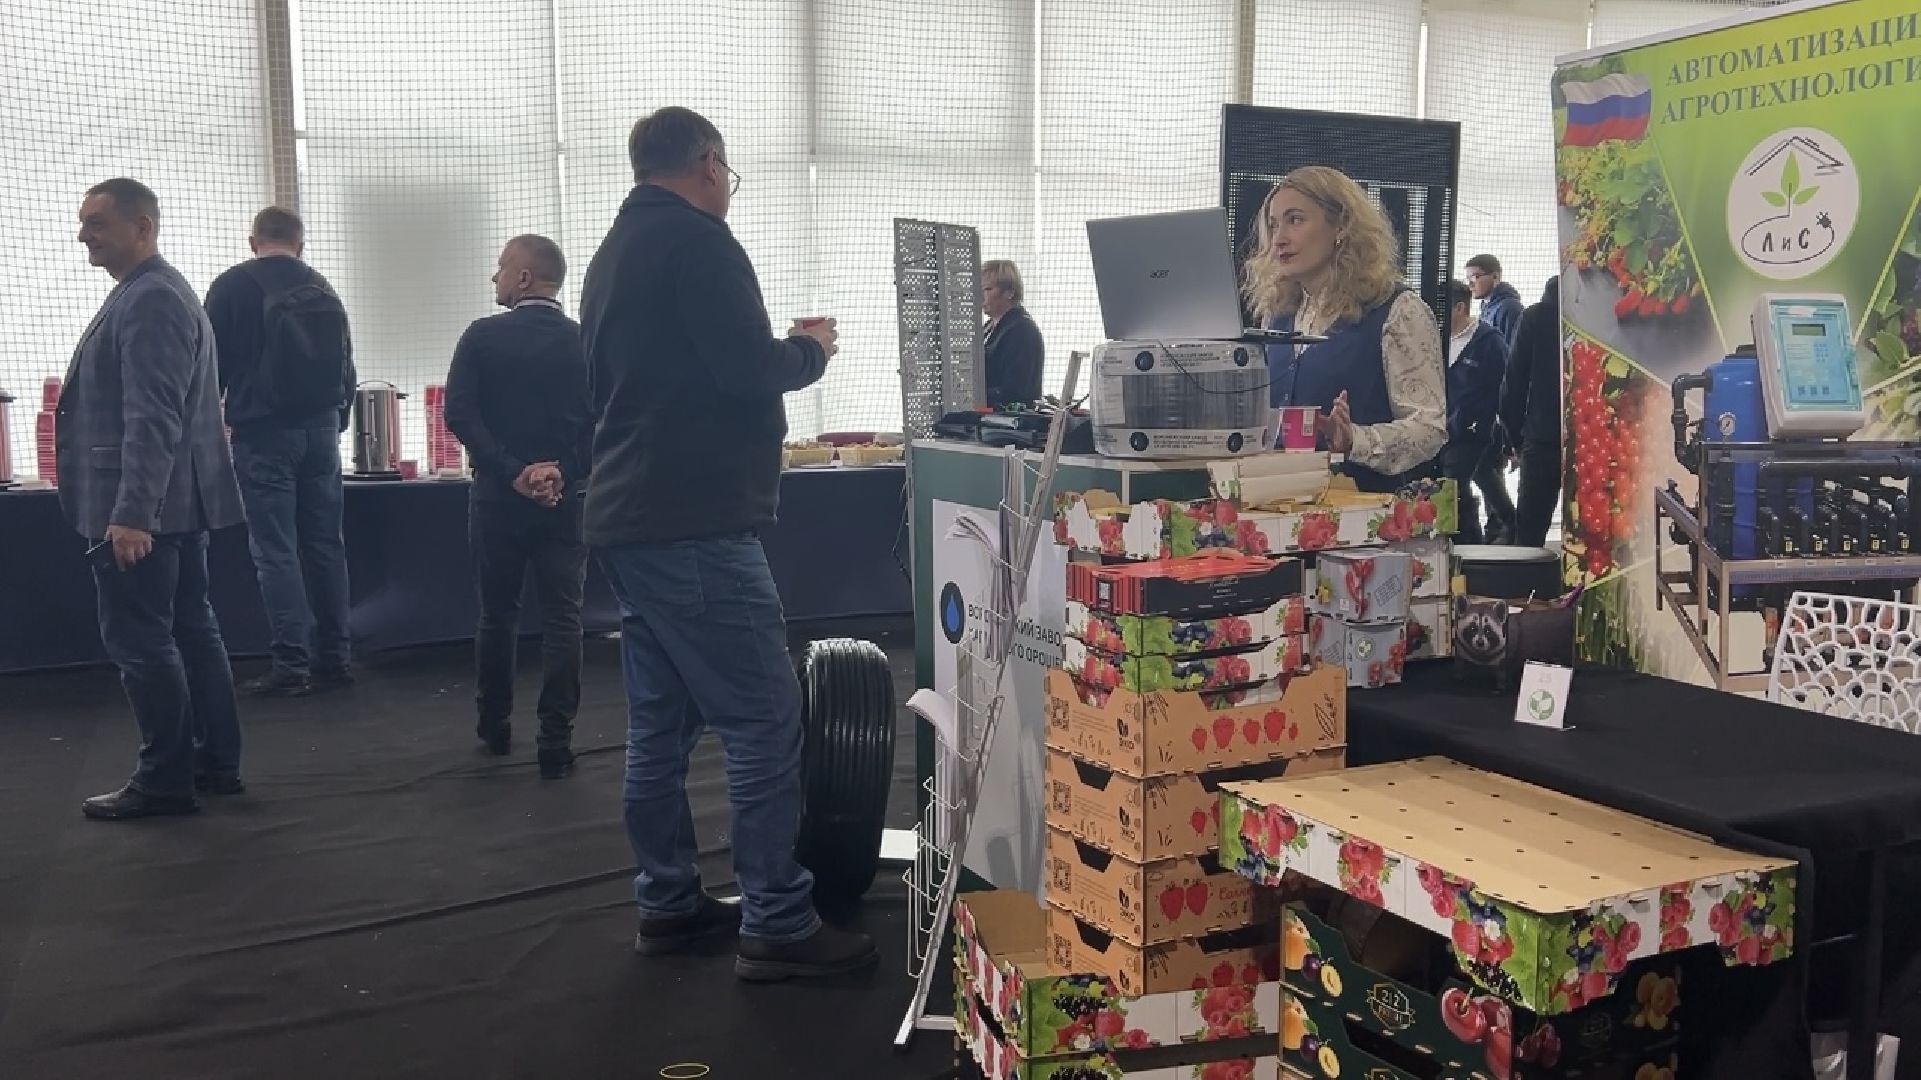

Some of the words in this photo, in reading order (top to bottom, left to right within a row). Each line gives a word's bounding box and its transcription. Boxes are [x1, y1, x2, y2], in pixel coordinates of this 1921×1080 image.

[1665, 12, 1921, 87] АВТОМАТИЗАЦИ
[1149, 269, 1170, 279] acer
[1035, 625, 1062, 647] ЗАВО
